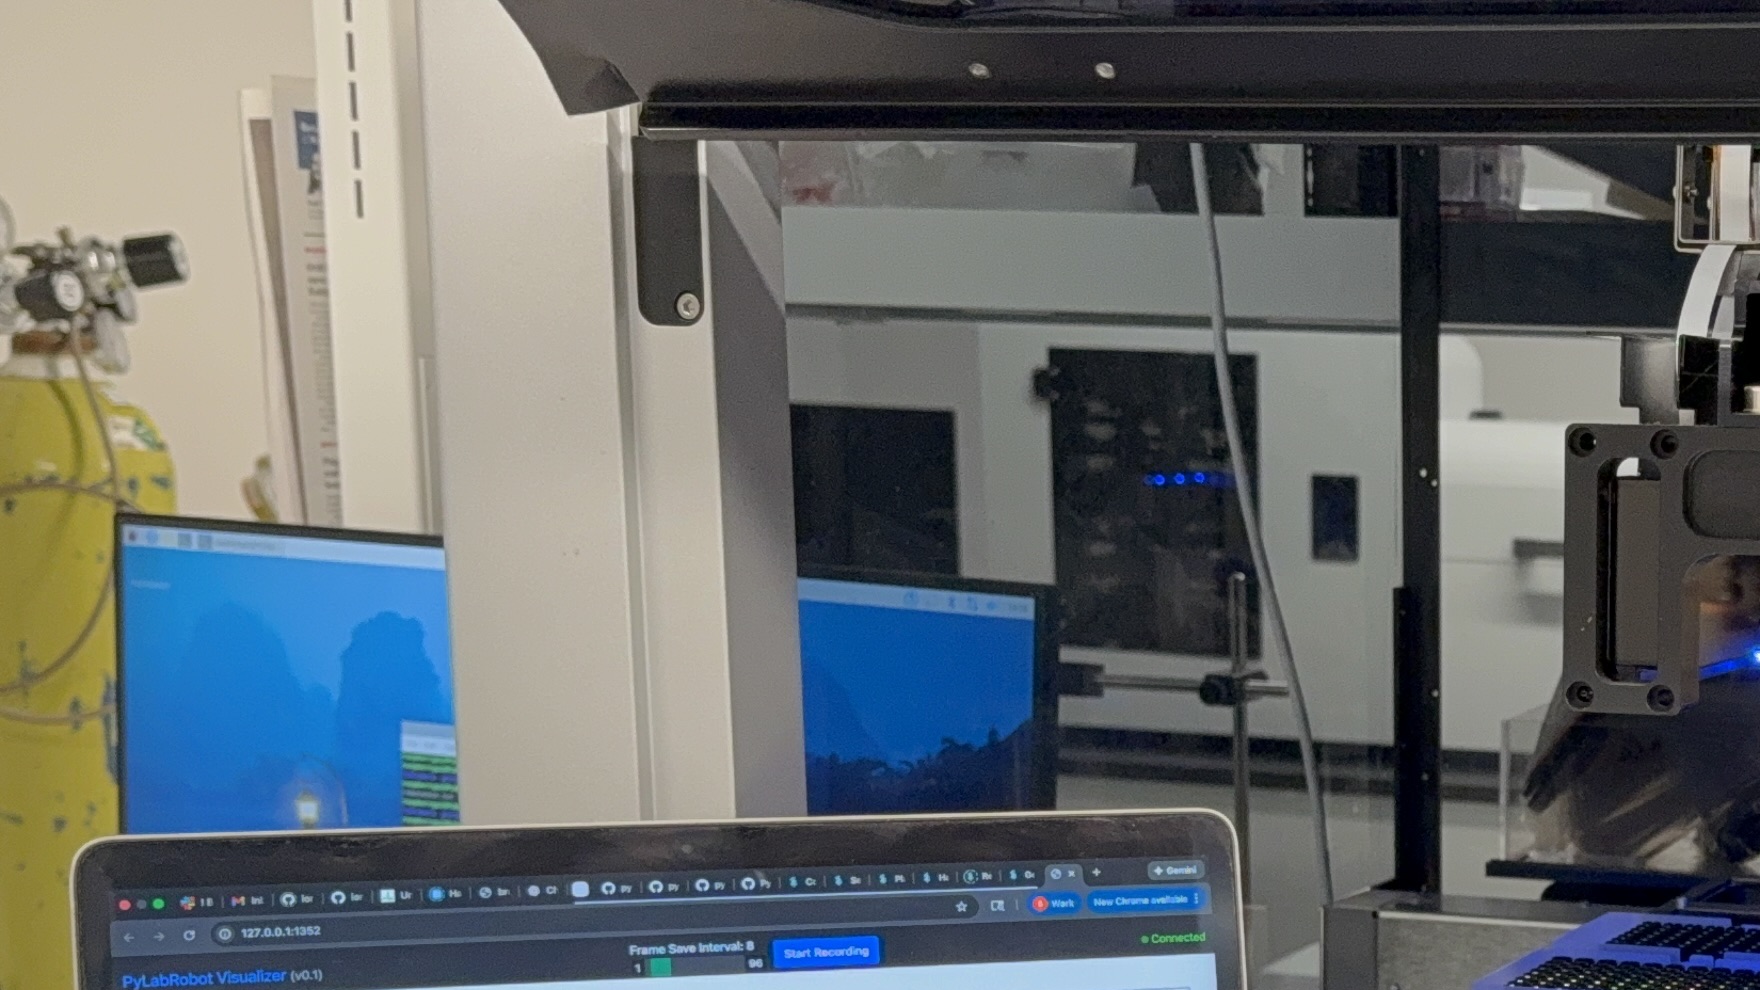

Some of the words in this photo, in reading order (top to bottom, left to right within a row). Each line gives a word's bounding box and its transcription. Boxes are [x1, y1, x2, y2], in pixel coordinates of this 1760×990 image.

[1166, 865, 1197, 875] Gemini
[1151, 932, 1206, 943] Connected
[629, 944, 666, 956] Frame
[668, 943, 696, 954] Save
[698, 941, 744, 953] Interval:
[784, 948, 812, 959] Start
[813, 945, 870, 958] Recording
[748, 959, 763, 969] 96
[122, 972, 213, 990] PyLabRobot
[217, 969, 287, 985] Visualizer
[290, 969, 323, 983] (v0.1)
